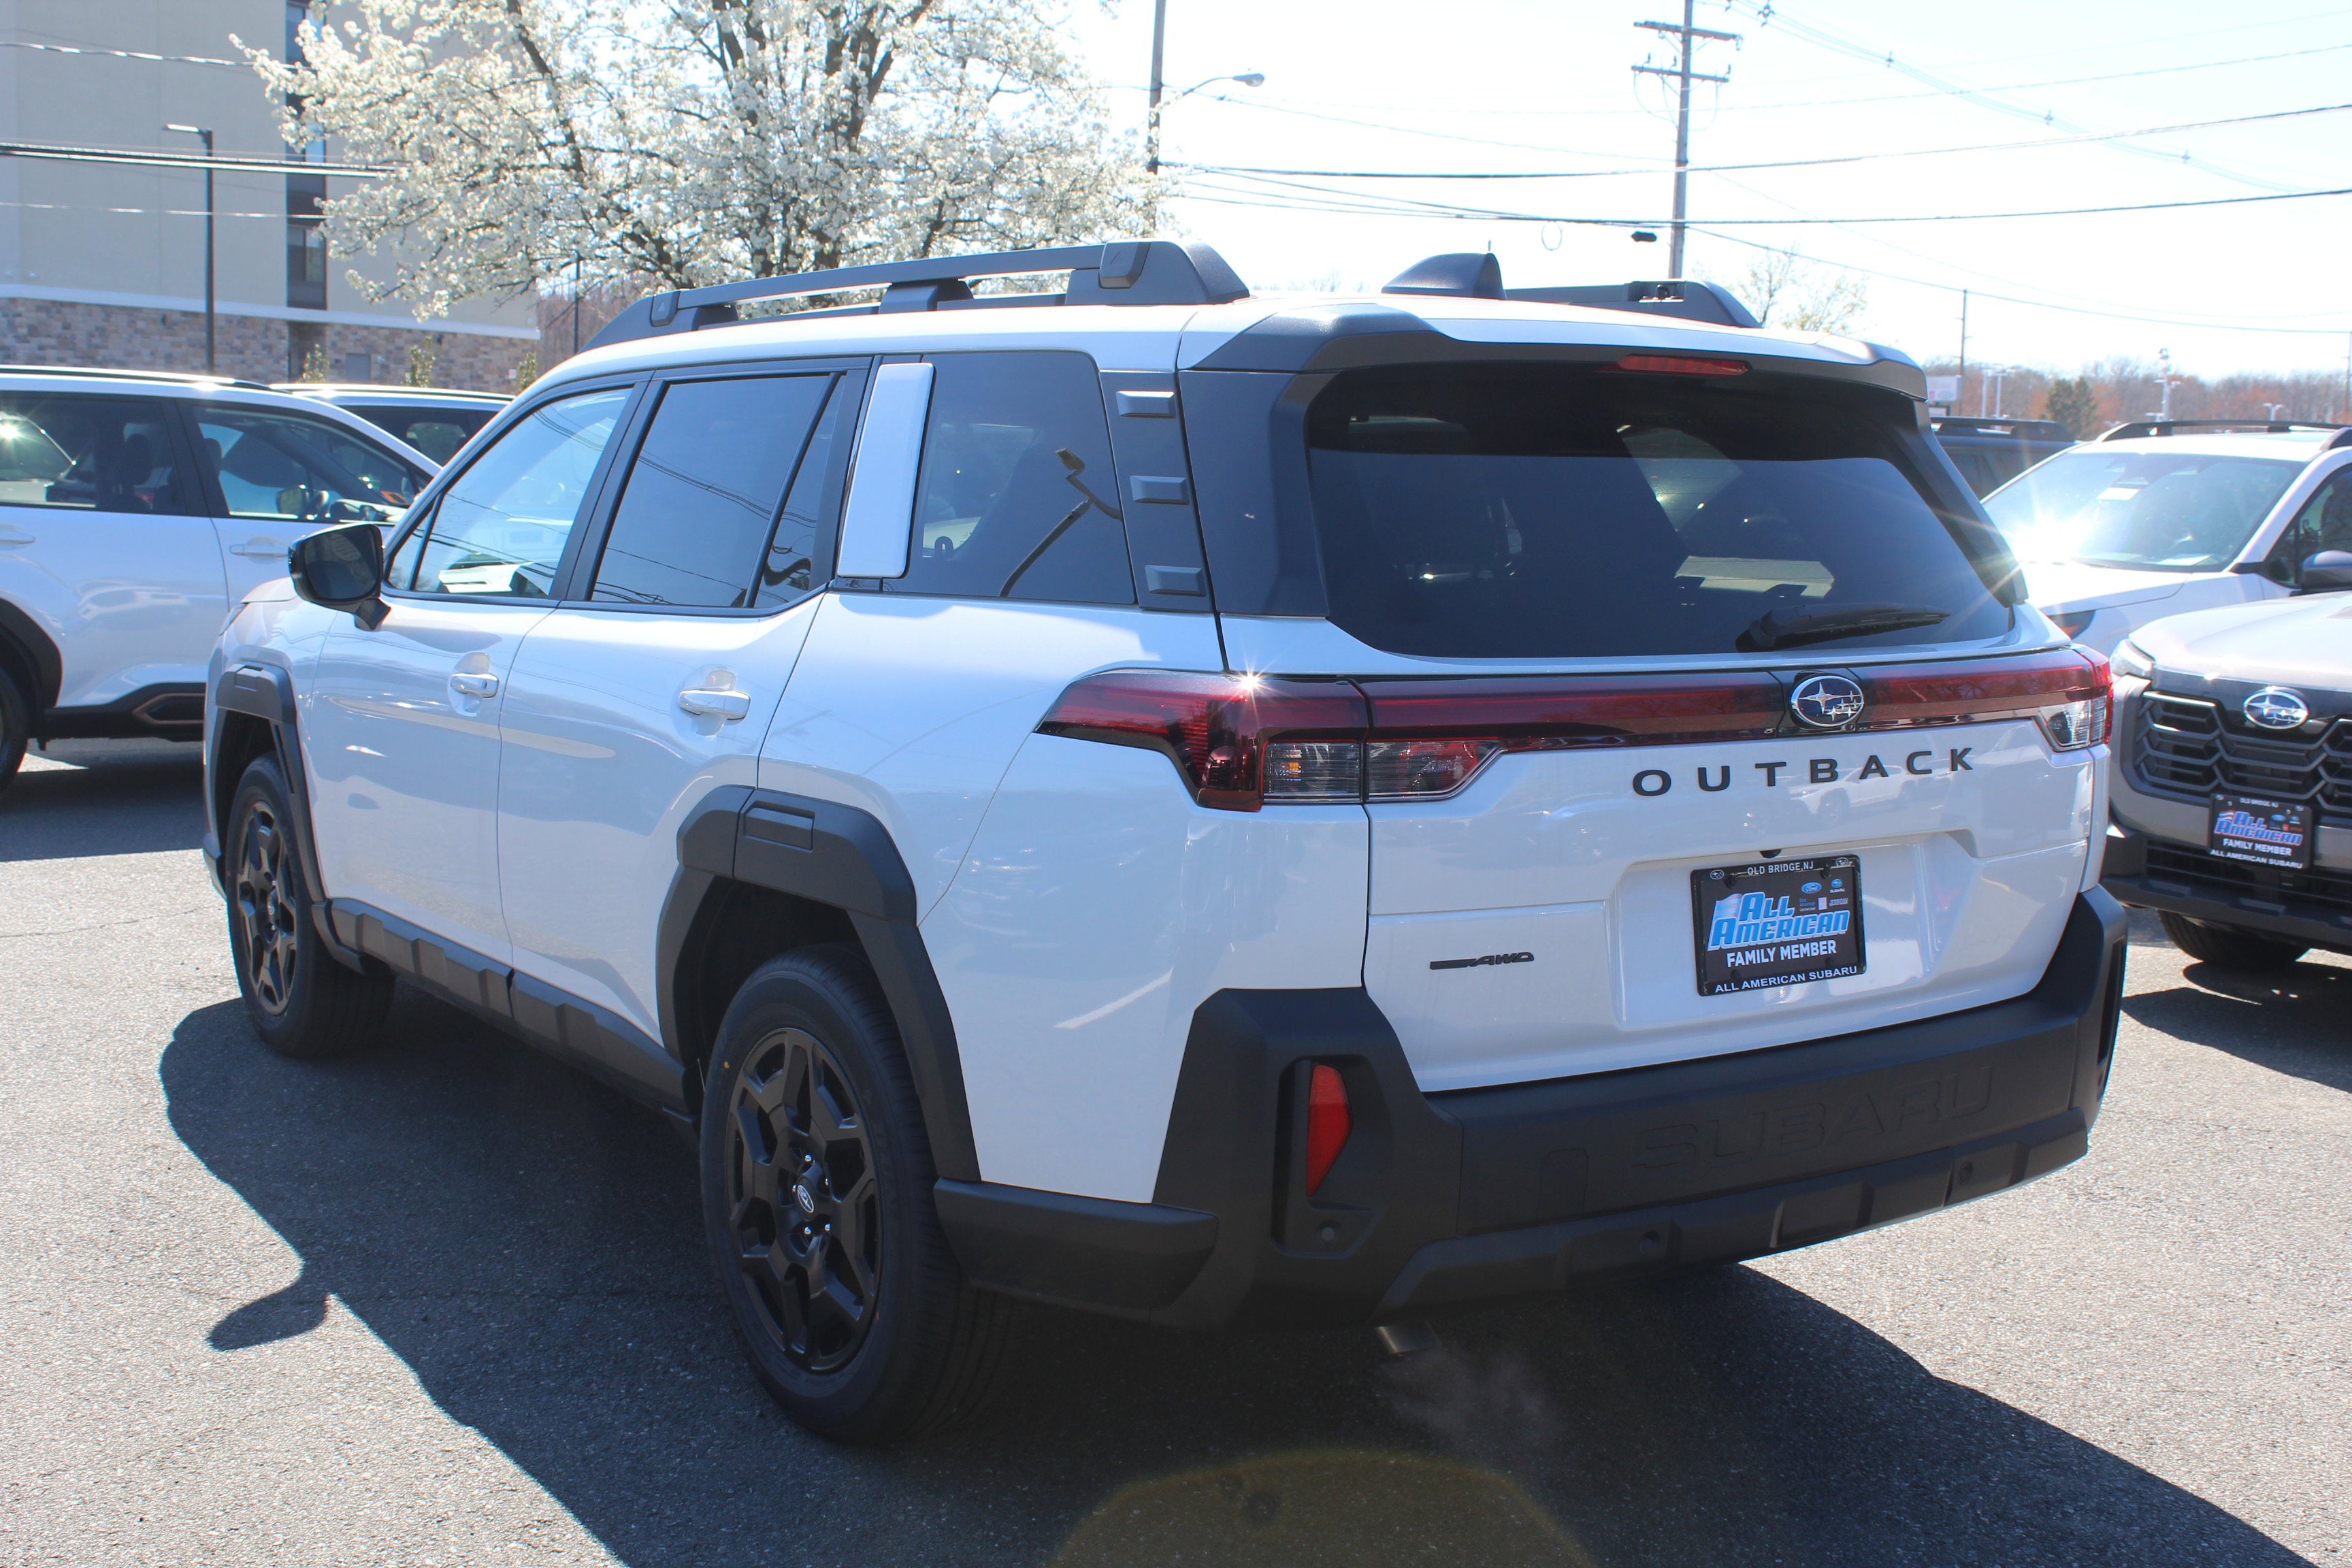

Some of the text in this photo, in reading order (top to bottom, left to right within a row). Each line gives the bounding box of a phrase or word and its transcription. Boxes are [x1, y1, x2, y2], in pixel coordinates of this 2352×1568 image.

[1633, 747, 1973, 796] OUTBACK
[2210, 849, 2303, 868] ALL AMERICAN SUBARU
[2223, 838, 2292, 856] FAMILY MEMBER
[1747, 866, 1765, 876] OLD
[1726, 939, 1837, 968] FAMILY MEMBER
[1714, 965, 1858, 994] ALL AMERICAN SUBARU
[1629, 1064, 1993, 1177] SUBARU
